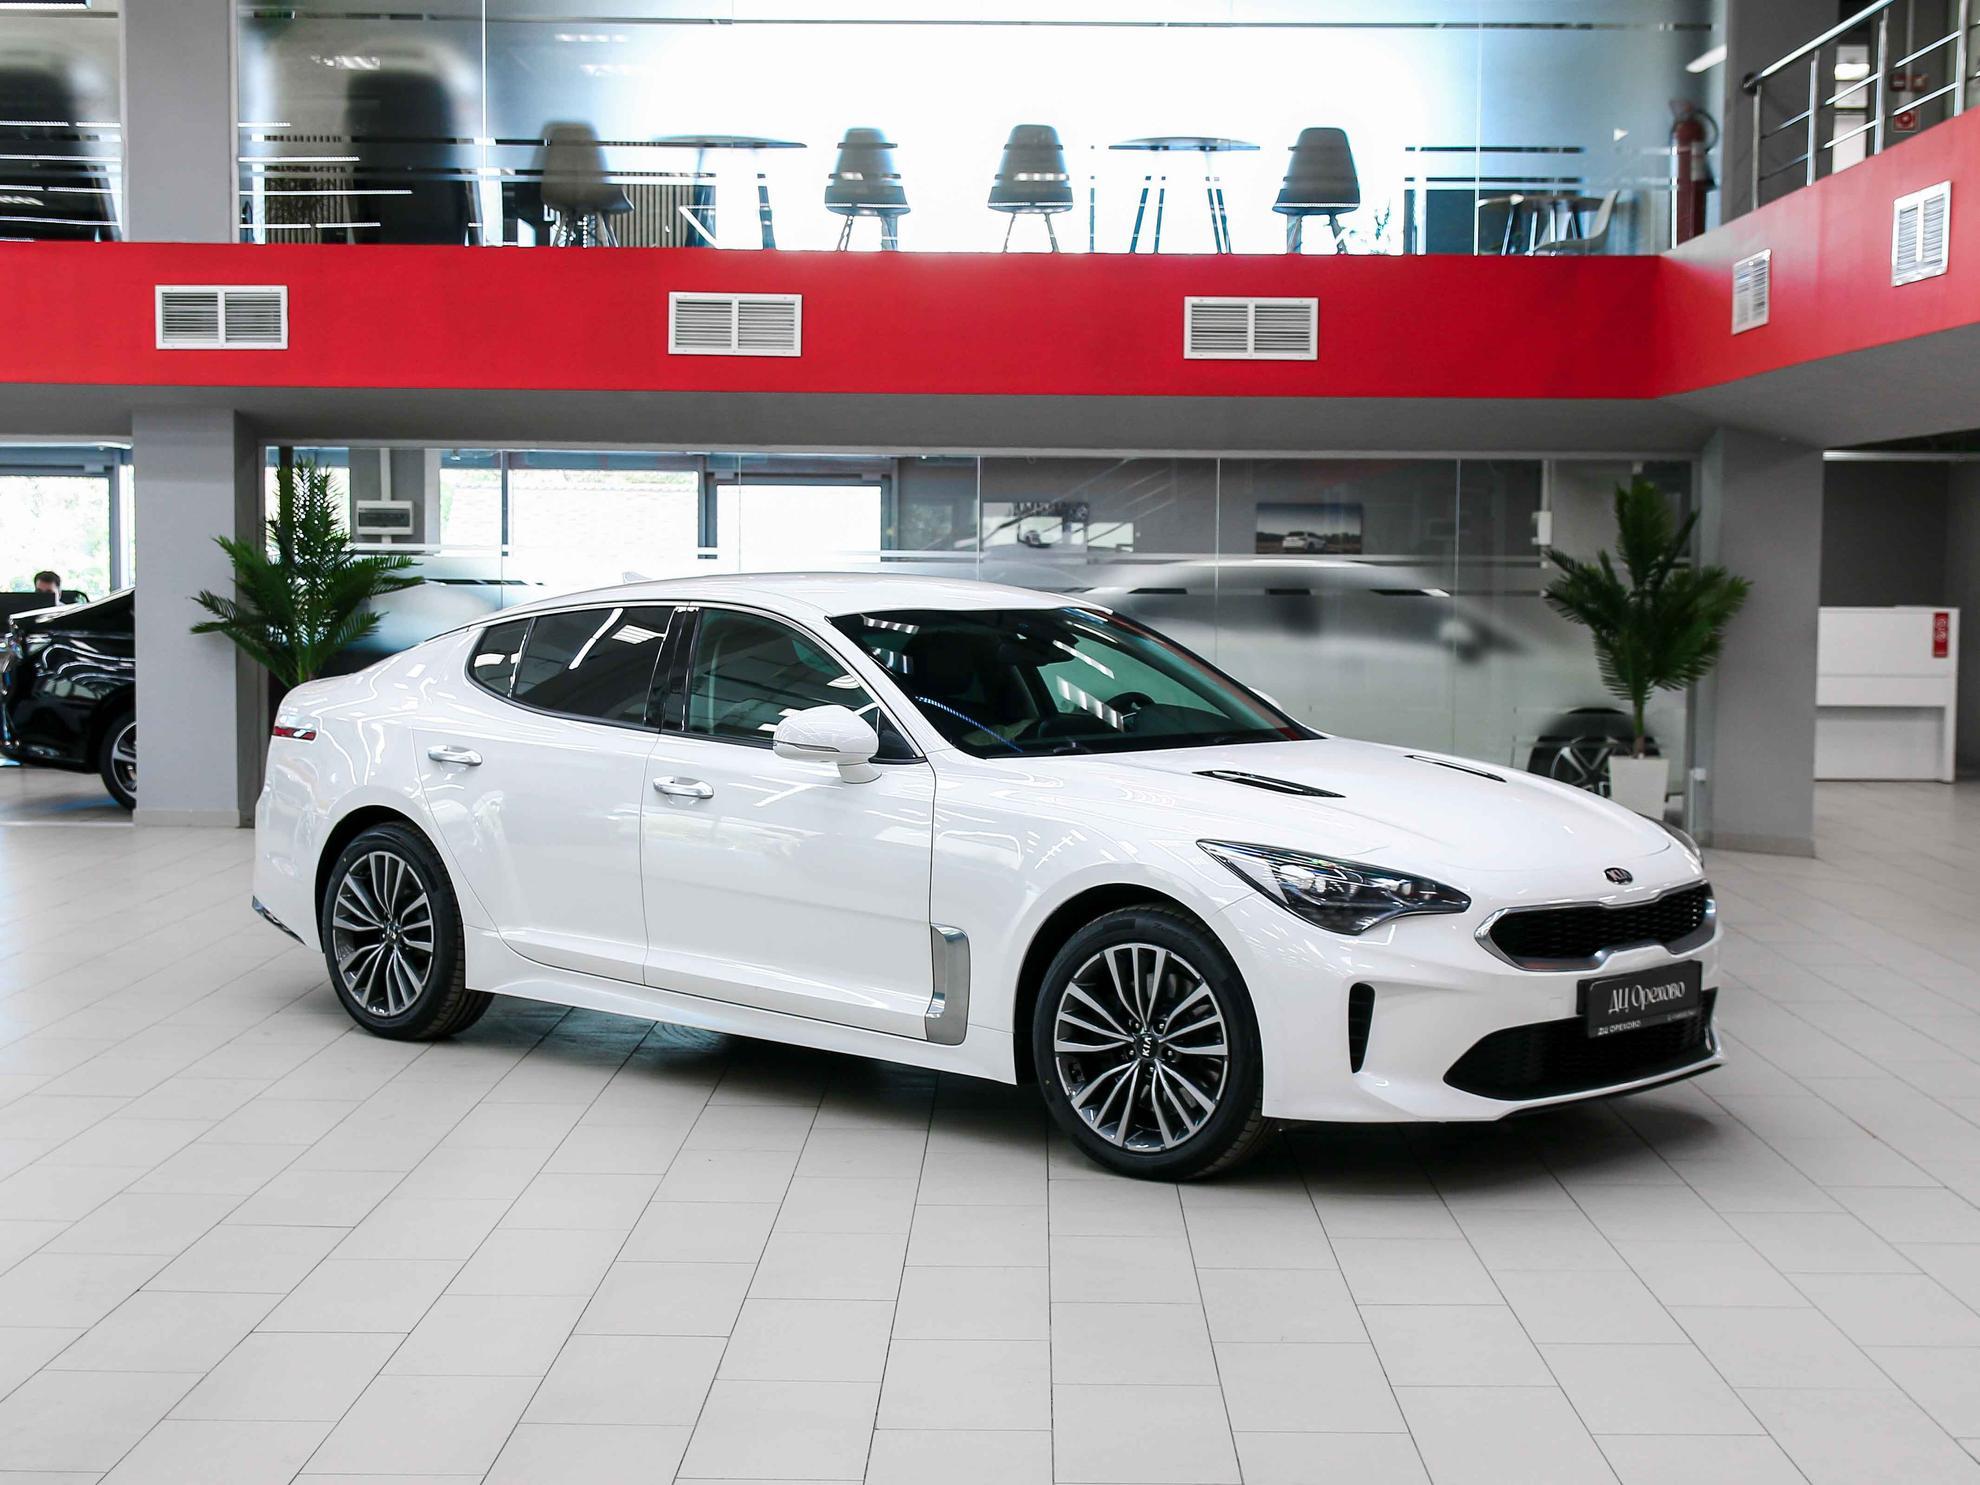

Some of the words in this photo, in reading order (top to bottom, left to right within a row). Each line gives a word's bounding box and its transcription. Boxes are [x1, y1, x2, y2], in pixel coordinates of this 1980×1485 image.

[1608, 986, 1630, 1015] ДЦ
[1631, 981, 1686, 1011] Орехово
[1142, 1037, 1153, 1057] KIA
